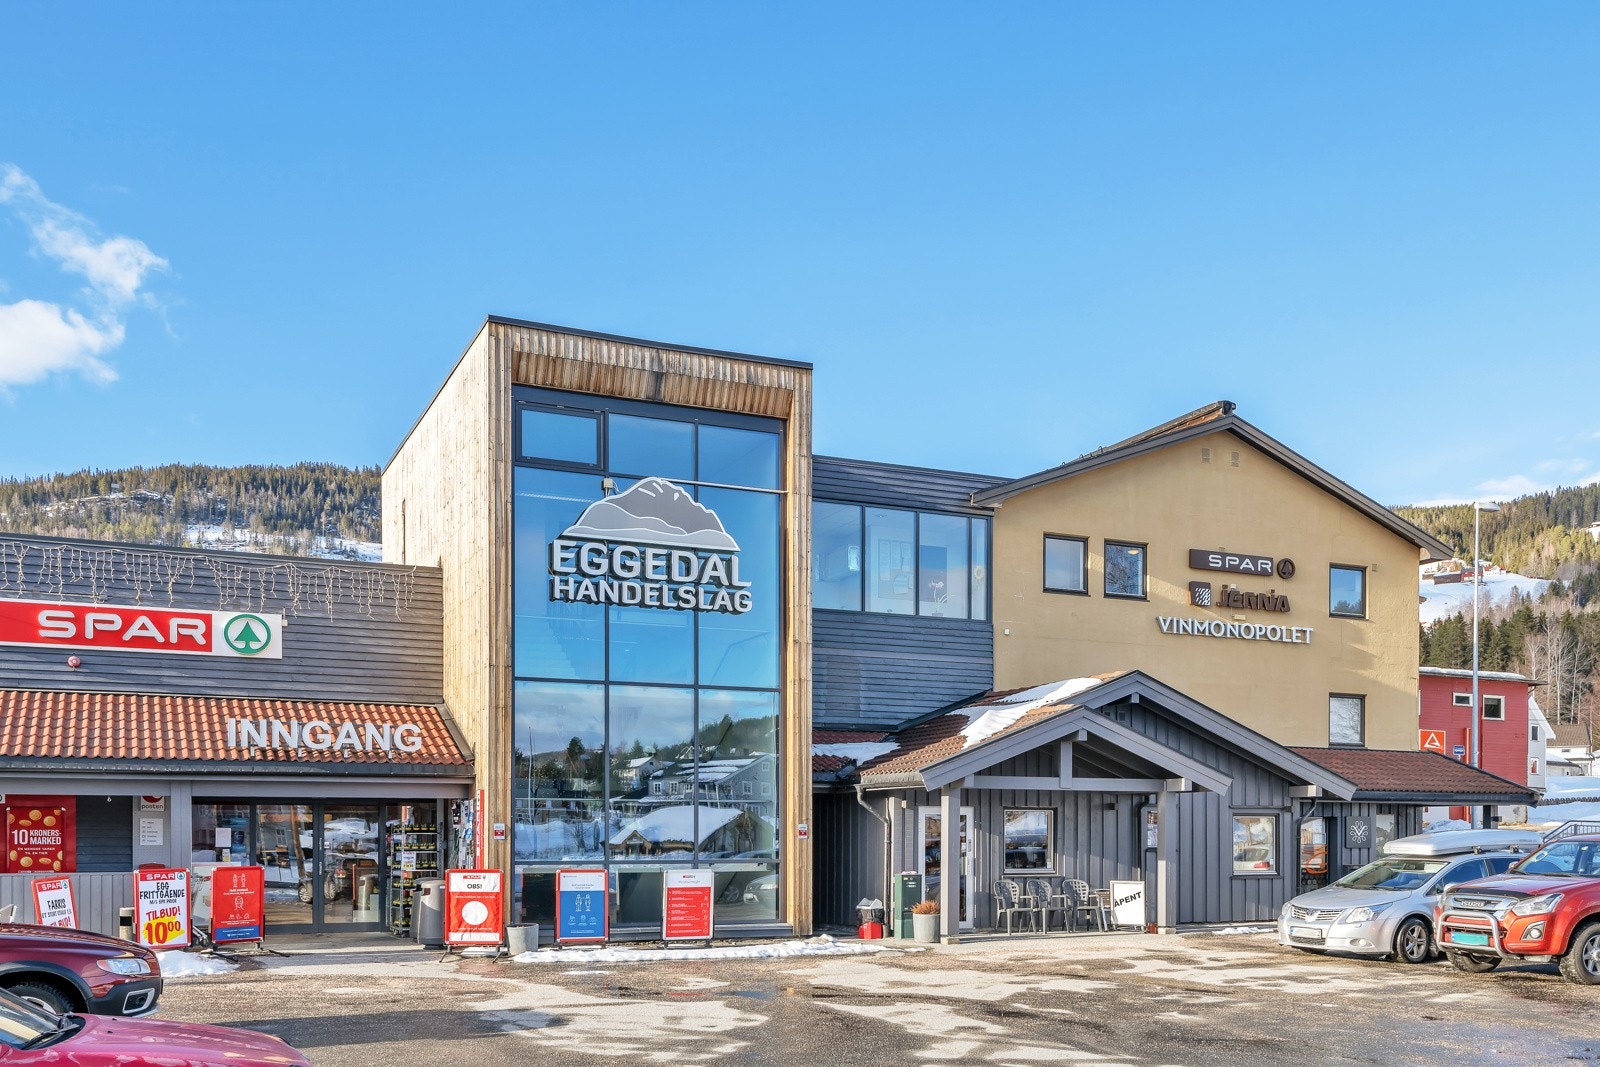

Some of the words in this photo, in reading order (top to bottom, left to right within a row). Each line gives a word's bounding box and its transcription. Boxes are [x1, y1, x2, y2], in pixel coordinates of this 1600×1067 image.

[550, 539, 752, 587] EGGEDAL
[1208, 554, 1272, 573] SPAR
[551, 576, 753, 613] HANDELSLAG
[37, 609, 207, 645] SPAR
[1156, 615, 1314, 644] VINMONOPOLET
[227, 717, 422, 752] INNGANG
[12, 829, 29, 845] 10
[29, 836, 62, 845] MARKED
[41, 882, 62, 891] SPAR
[139, 888, 186, 900] FRITTGÅENDE
[156, 881, 170, 891] EGG
[1114, 891, 1142, 908] ÅPENT
[145, 905, 181, 921] TILBUD!
